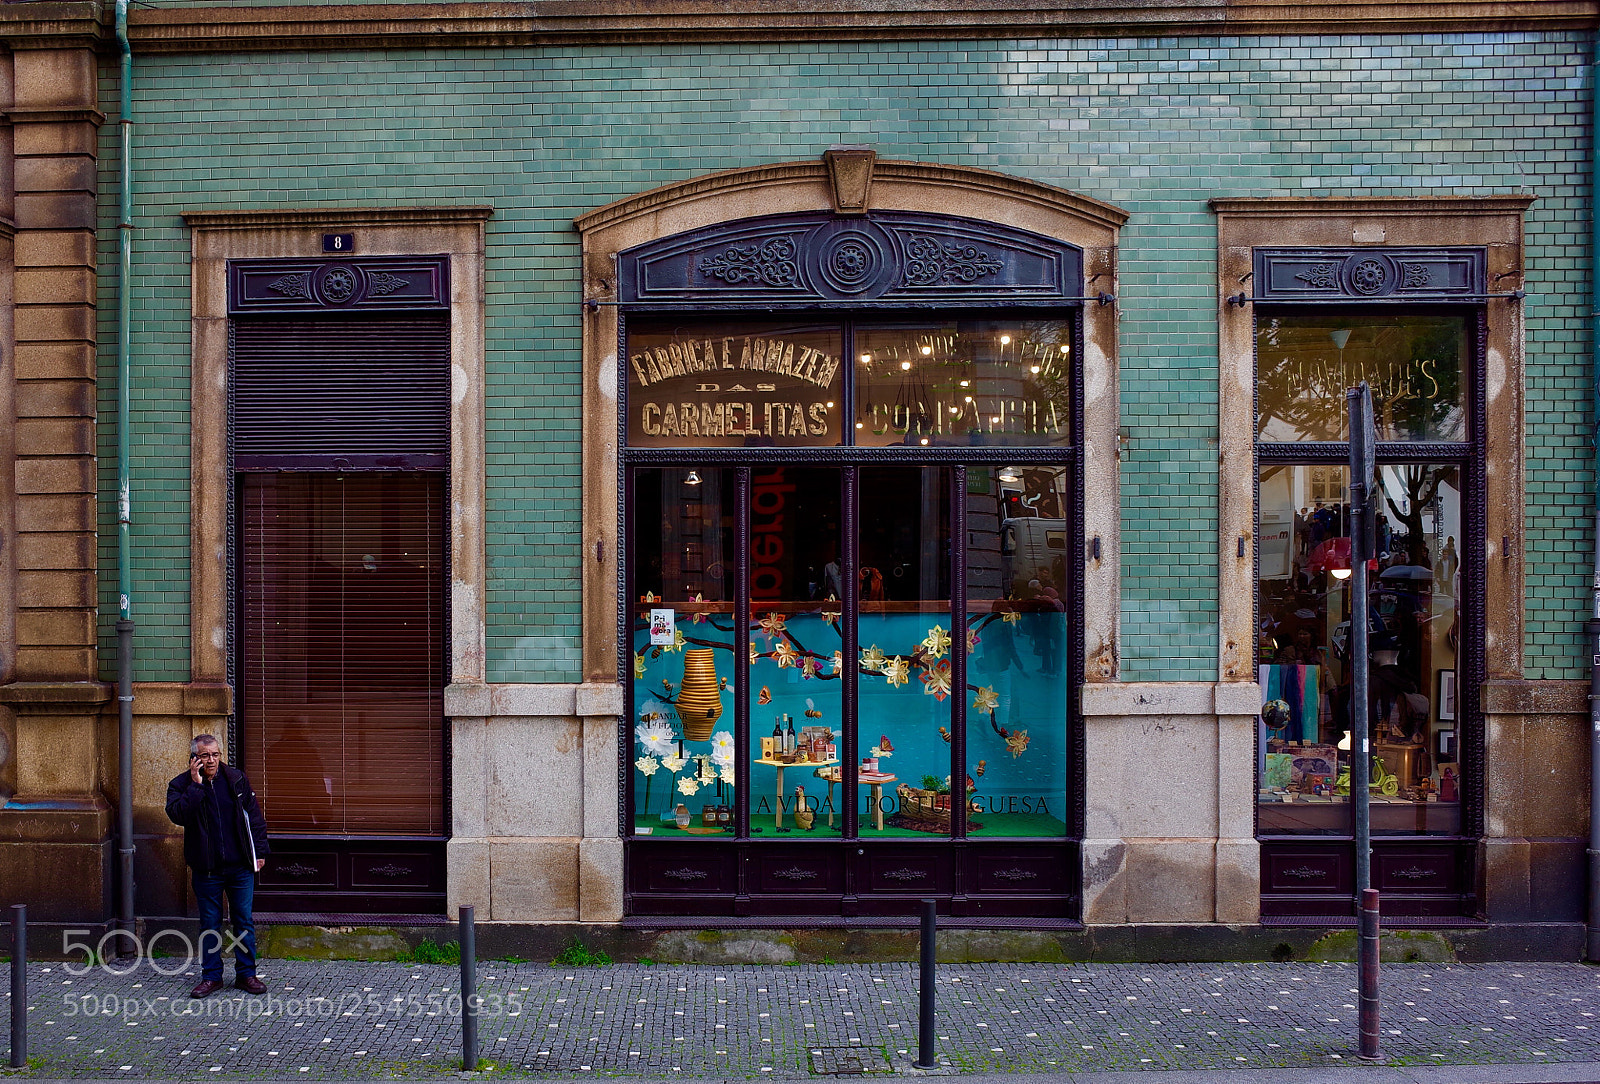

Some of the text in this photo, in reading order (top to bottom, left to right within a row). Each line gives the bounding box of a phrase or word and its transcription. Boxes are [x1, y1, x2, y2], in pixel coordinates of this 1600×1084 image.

[334, 236, 342, 249] 8
[722, 336, 734, 370] E
[696, 383, 776, 392] DAS
[642, 402, 828, 437] CARMELITAS
[658, 722, 689, 730] FLOOR
[757, 795, 771, 813] A
[778, 795, 835, 813] VIDA
